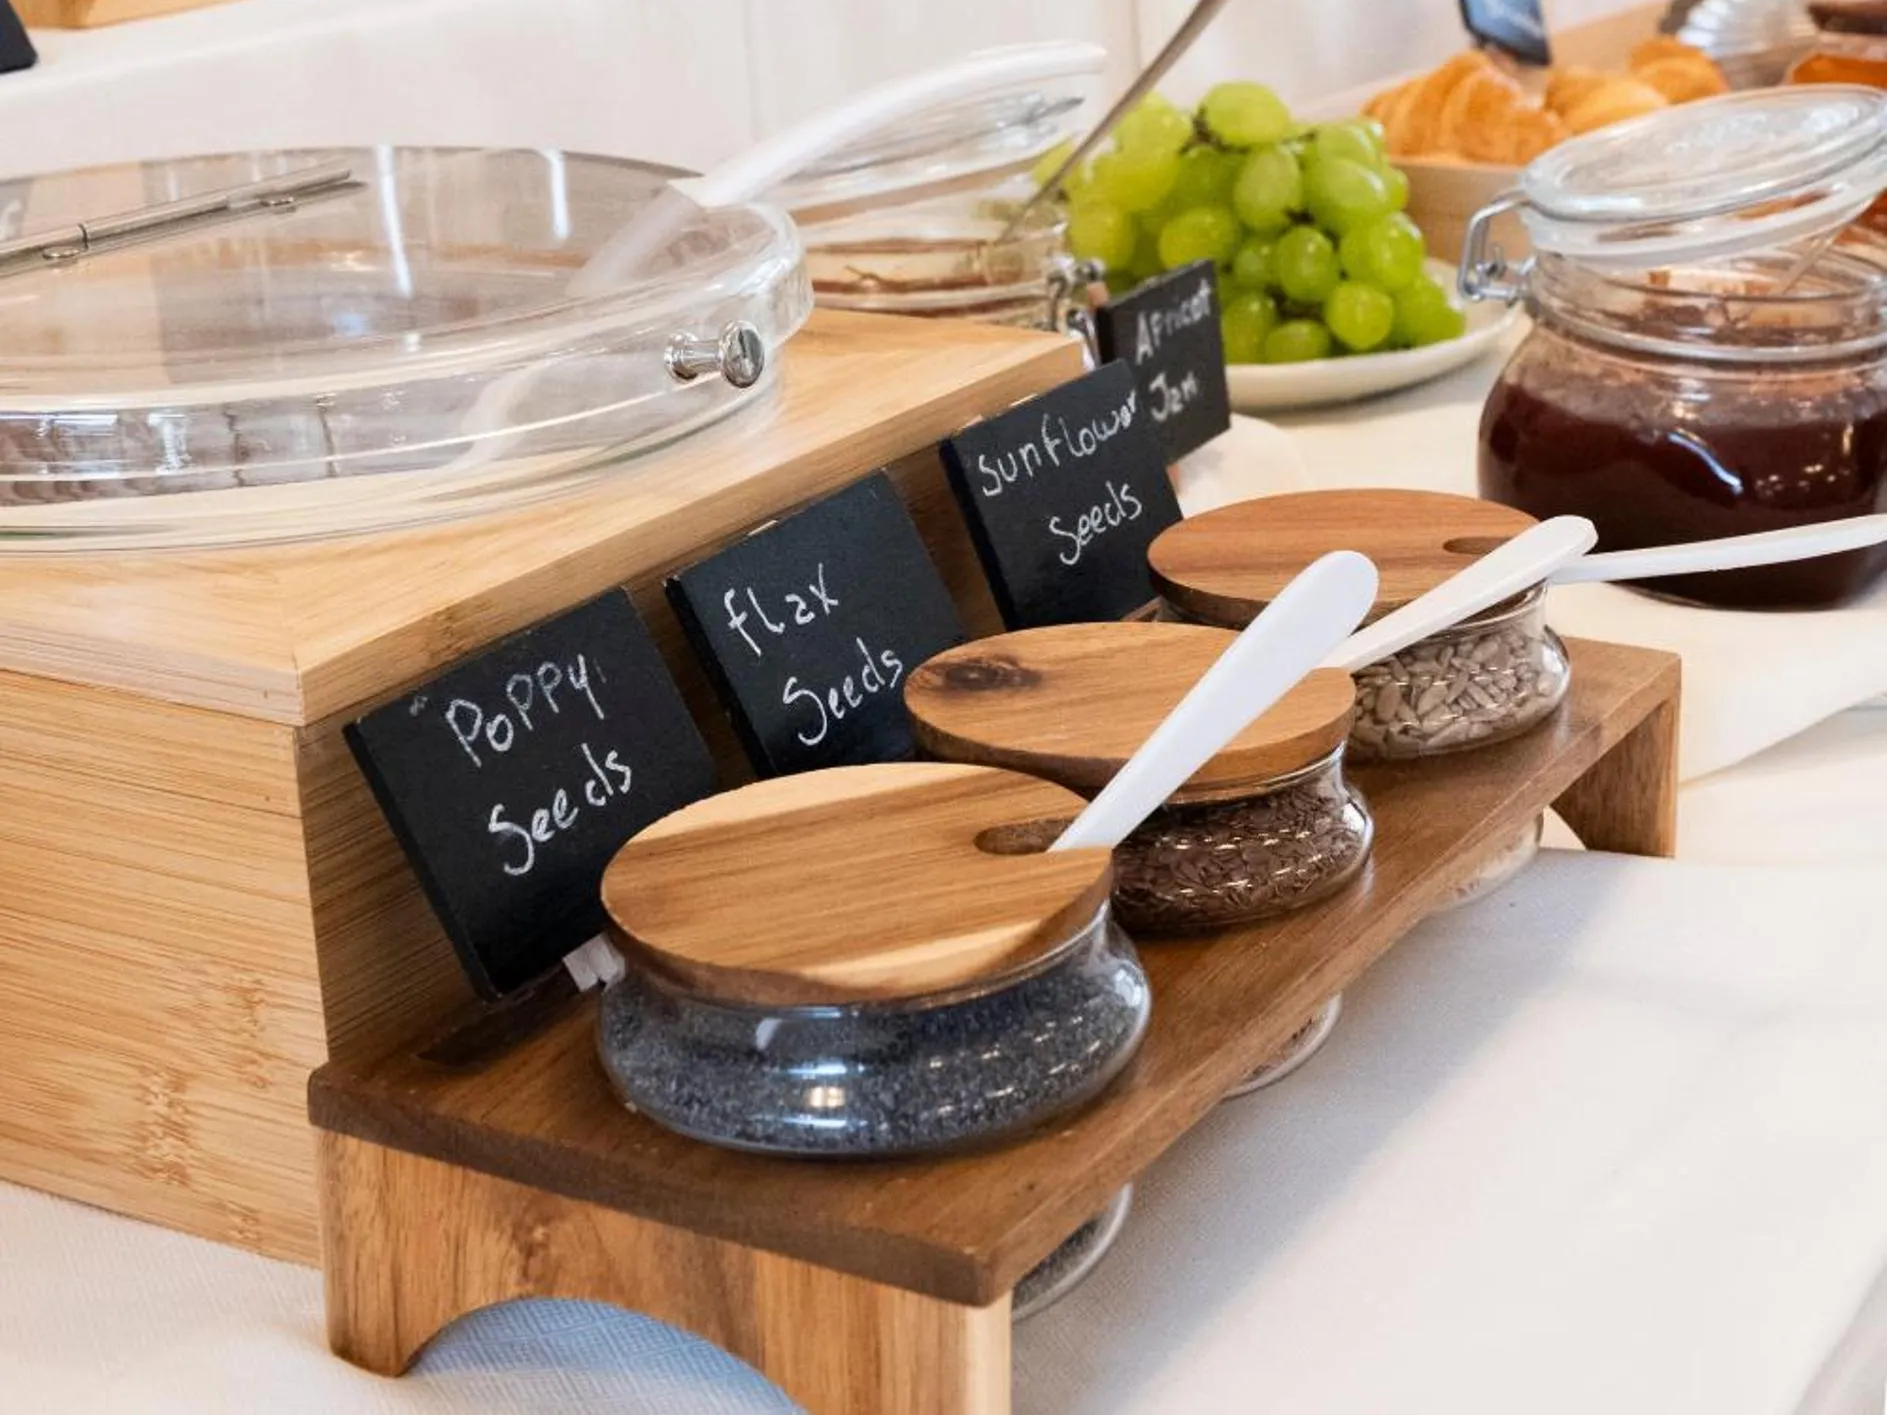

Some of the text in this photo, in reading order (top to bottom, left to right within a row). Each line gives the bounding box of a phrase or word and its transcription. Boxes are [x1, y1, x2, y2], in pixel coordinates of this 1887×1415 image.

[978, 387, 1137, 497] Sunflower
[1048, 480, 1143, 566] Seeds
[782, 636, 903, 746] Seeds
[488, 742, 632, 876] Seeds
